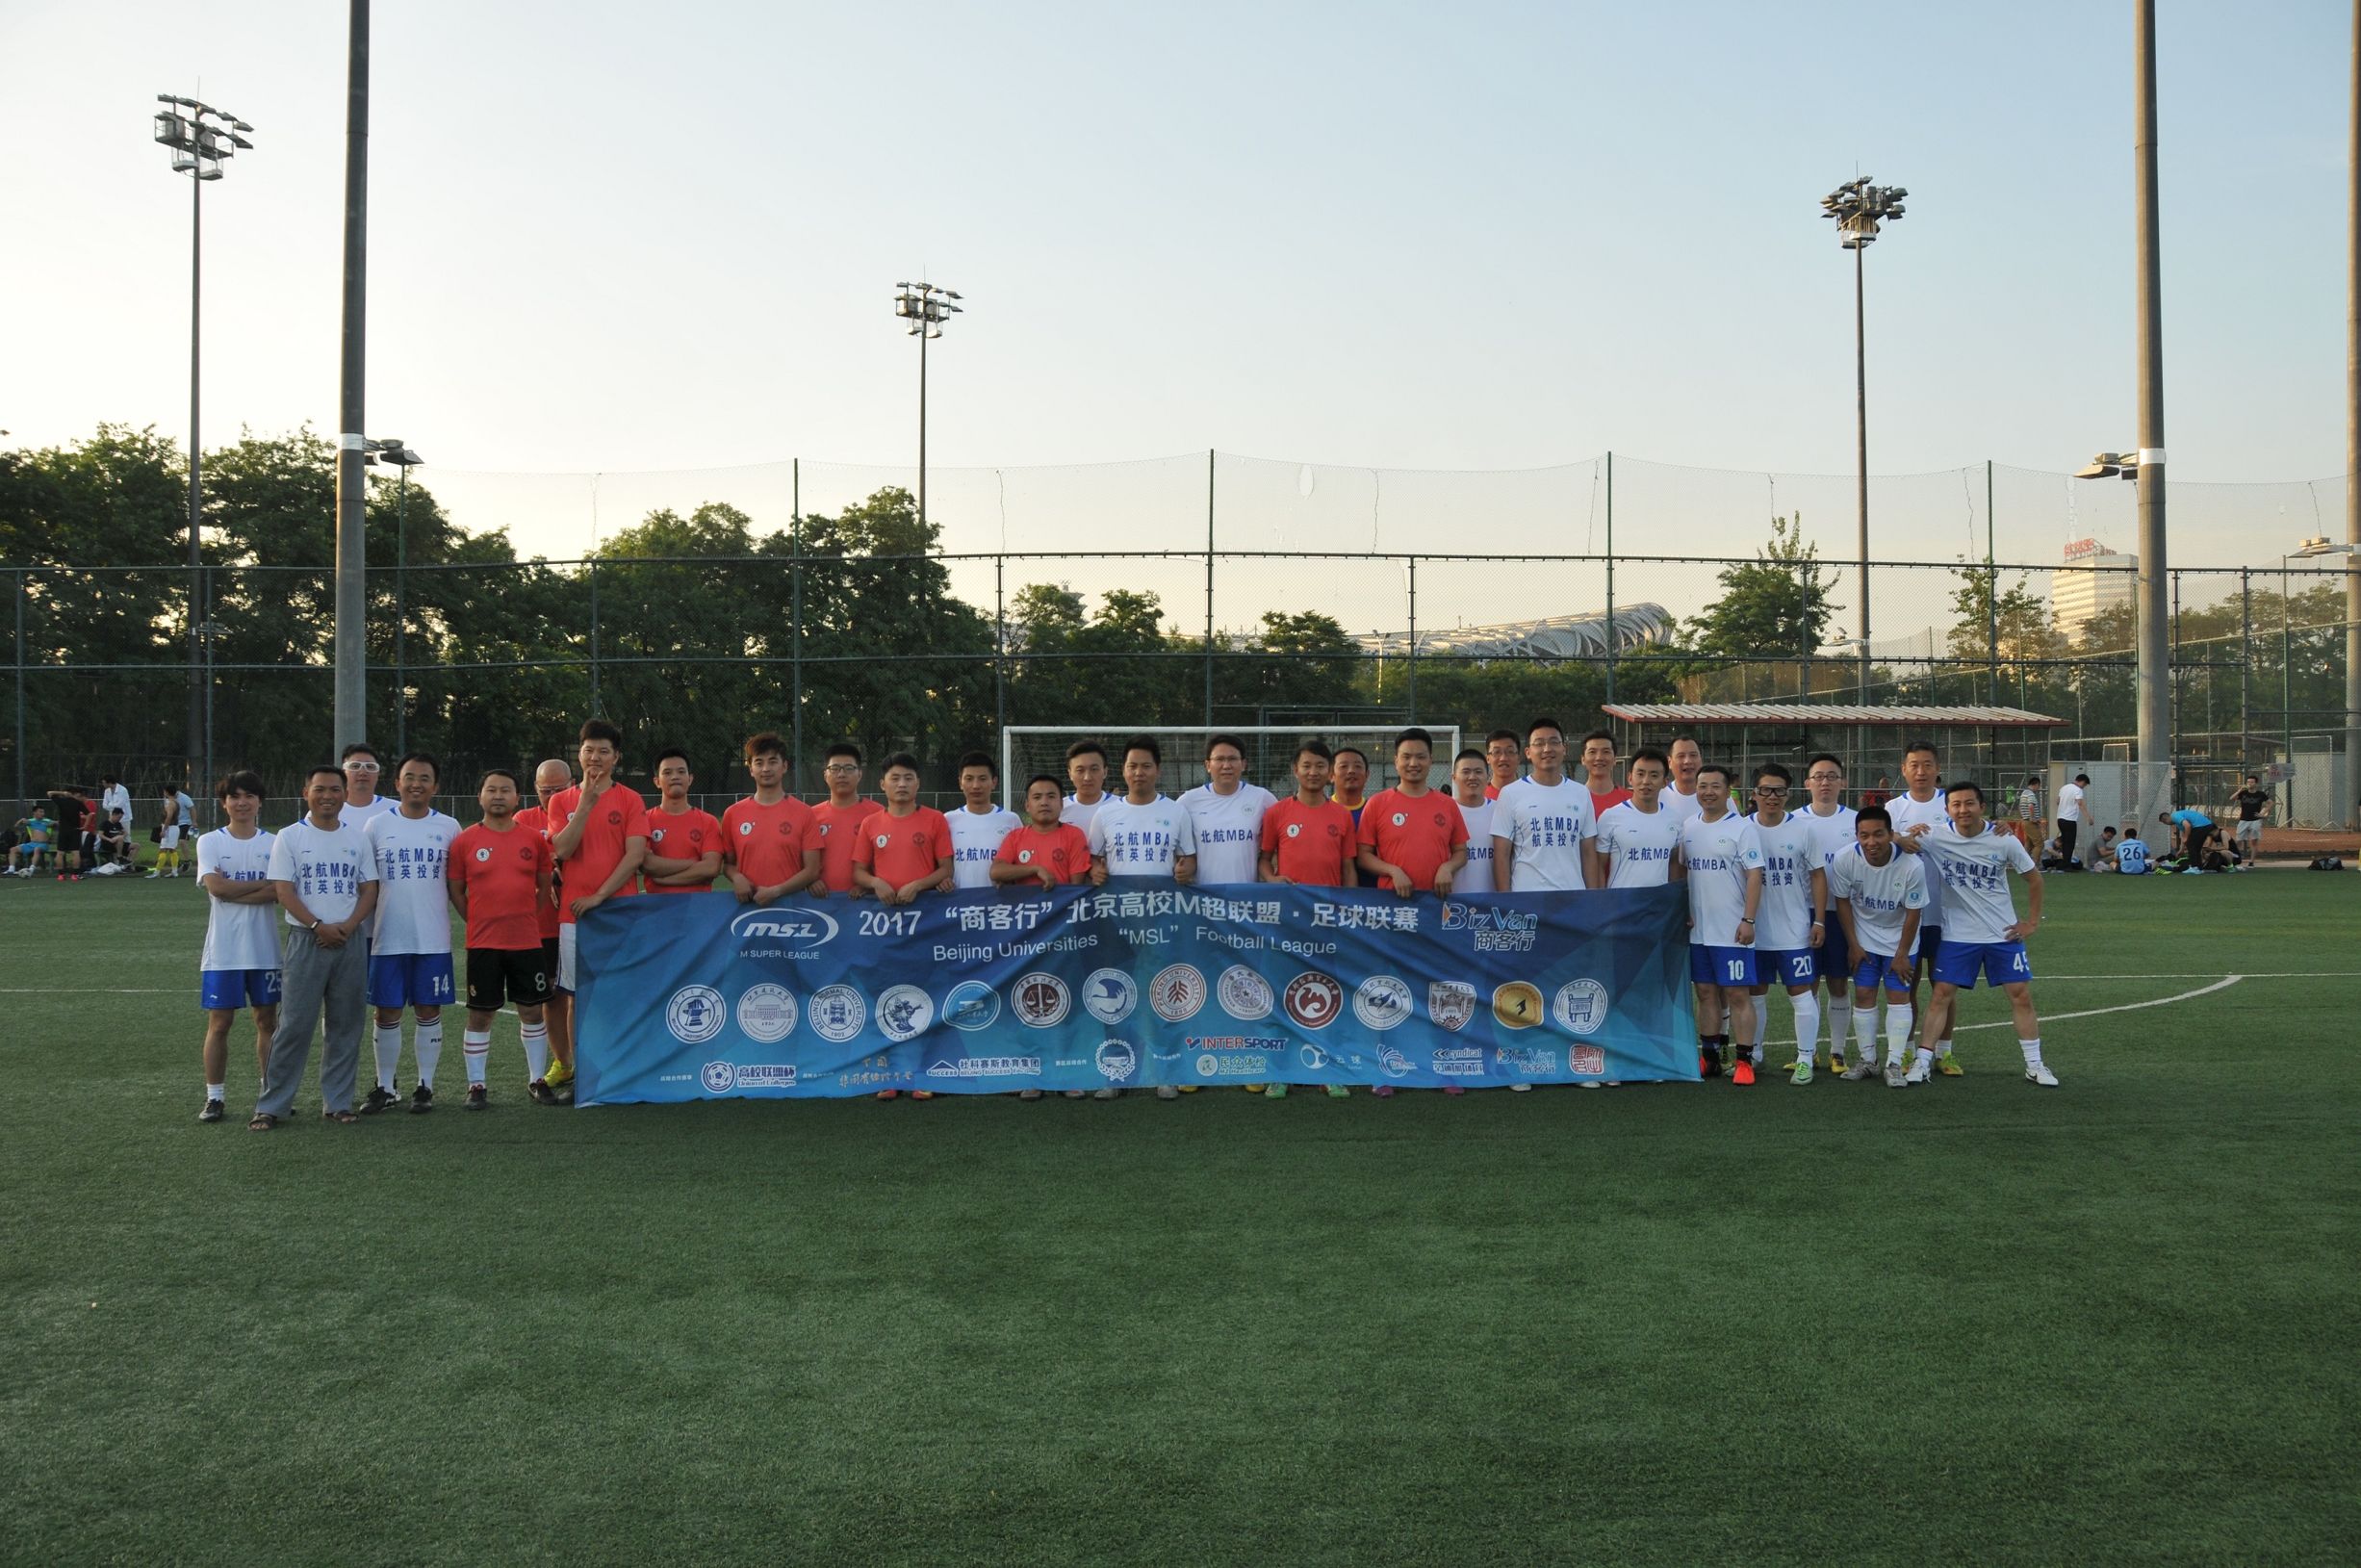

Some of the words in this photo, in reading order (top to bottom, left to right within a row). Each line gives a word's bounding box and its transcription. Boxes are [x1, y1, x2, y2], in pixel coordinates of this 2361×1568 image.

[1114, 832, 1169, 847] 北航MBA
[1200, 829, 1253, 843] 北航MBA
[384, 847, 442, 864] 北航MBA
[2122, 846, 2141, 861] 26
[859, 911, 922, 937] 2017
[934, 942, 992, 963] Beijing
[998, 933, 1098, 958] Universities
[1196, 926, 1264, 949] Football
[1270, 937, 1337, 957] League
[1475, 930, 1535, 952] 商客行
[750, 950, 781, 959] SUPER
[783, 951, 819, 960] LEAGUE
[1728, 960, 1744, 981] 10
[1792, 955, 1812, 977] 20
[265, 972, 282, 993] 25
[432, 973, 449, 996] 14
[534, 972, 547, 991] 8
[1157, 978, 1168, 1006] PEKING
[1168, 970, 1200, 1001] UNIVERSITY
[818, 988, 844, 1001] NORMAL
[813, 1001, 825, 1031] BEIJING
[846, 990, 862, 1031] UNIVERSITY
[1202, 1037, 1287, 1051] INTERSPORT
[738, 1066, 796, 1079] 高校联盟杯
[961, 1058, 1039, 1069] 社科赛斯教育集团
